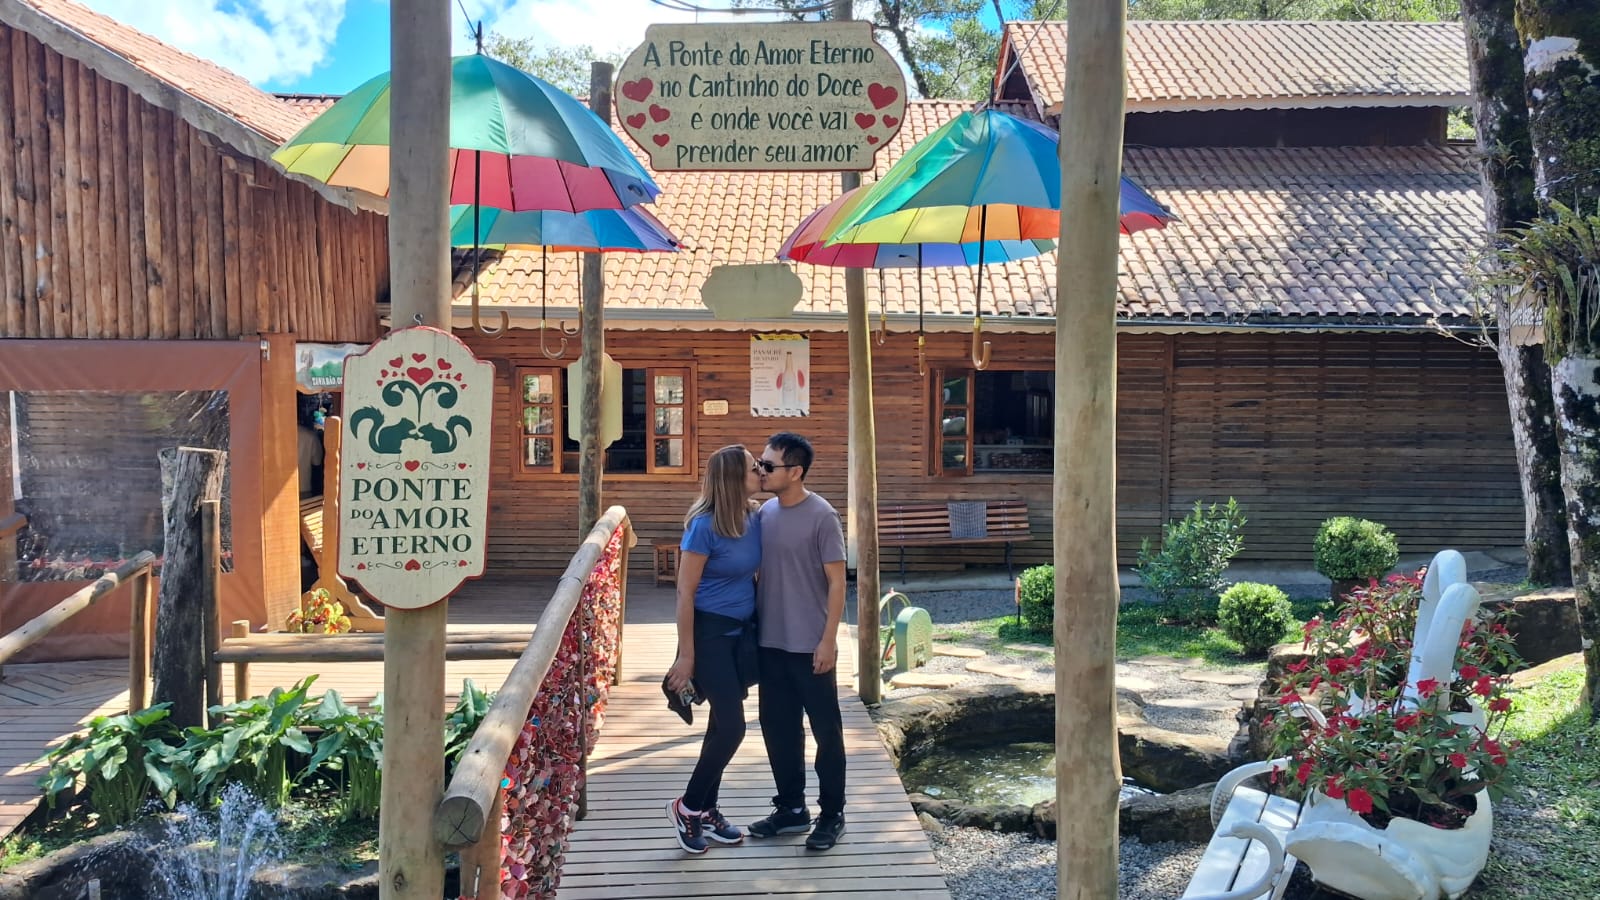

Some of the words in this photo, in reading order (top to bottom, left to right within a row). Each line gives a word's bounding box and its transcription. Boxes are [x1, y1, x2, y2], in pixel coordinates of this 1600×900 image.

[643, 41, 661, 67] A
[669, 40, 723, 66] Ponte
[729, 41, 750, 66] do
[754, 39, 806, 65] Amor
[810, 39, 874, 65] Eterno
[660, 79, 682, 97] no
[688, 71, 779, 97] Cantinho
[786, 73, 809, 97] do
[817, 72, 863, 97] Doce
[690, 103, 703, 130] é
[711, 105, 761, 130] onde
[767, 105, 813, 130] você
[819, 111, 847, 130] vai
[676, 138, 760, 168] prender
[764, 145, 796, 162] seu
[351, 477, 472, 502] PONTE
[350, 508, 374, 520] DO
[369, 506, 473, 530] AMOR
[351, 533, 472, 556] ETERNO
